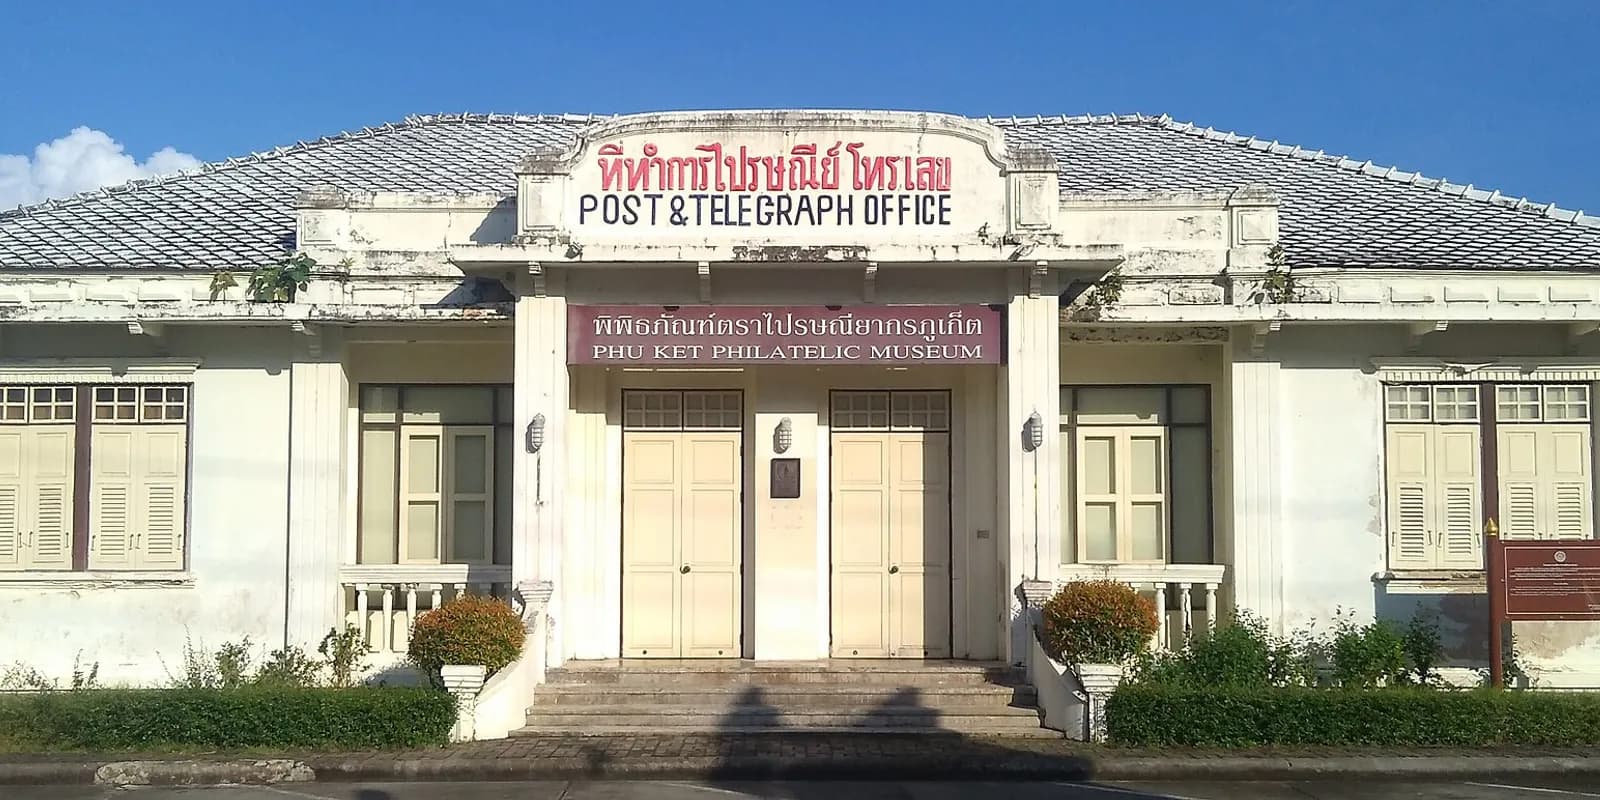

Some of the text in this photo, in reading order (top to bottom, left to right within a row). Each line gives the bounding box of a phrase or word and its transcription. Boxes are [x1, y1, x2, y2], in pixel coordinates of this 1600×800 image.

[846, 142, 952, 192] โทรเลข
[579, 194, 664, 226] POST
[864, 194, 952, 226] OFFICE
[592, 309, 983, 343] พิพิธภัณฑ์ตราไปรษณียากรภูเก็ต
[591, 344, 983, 360] PHU KET PHILATELIC MUSEUM
